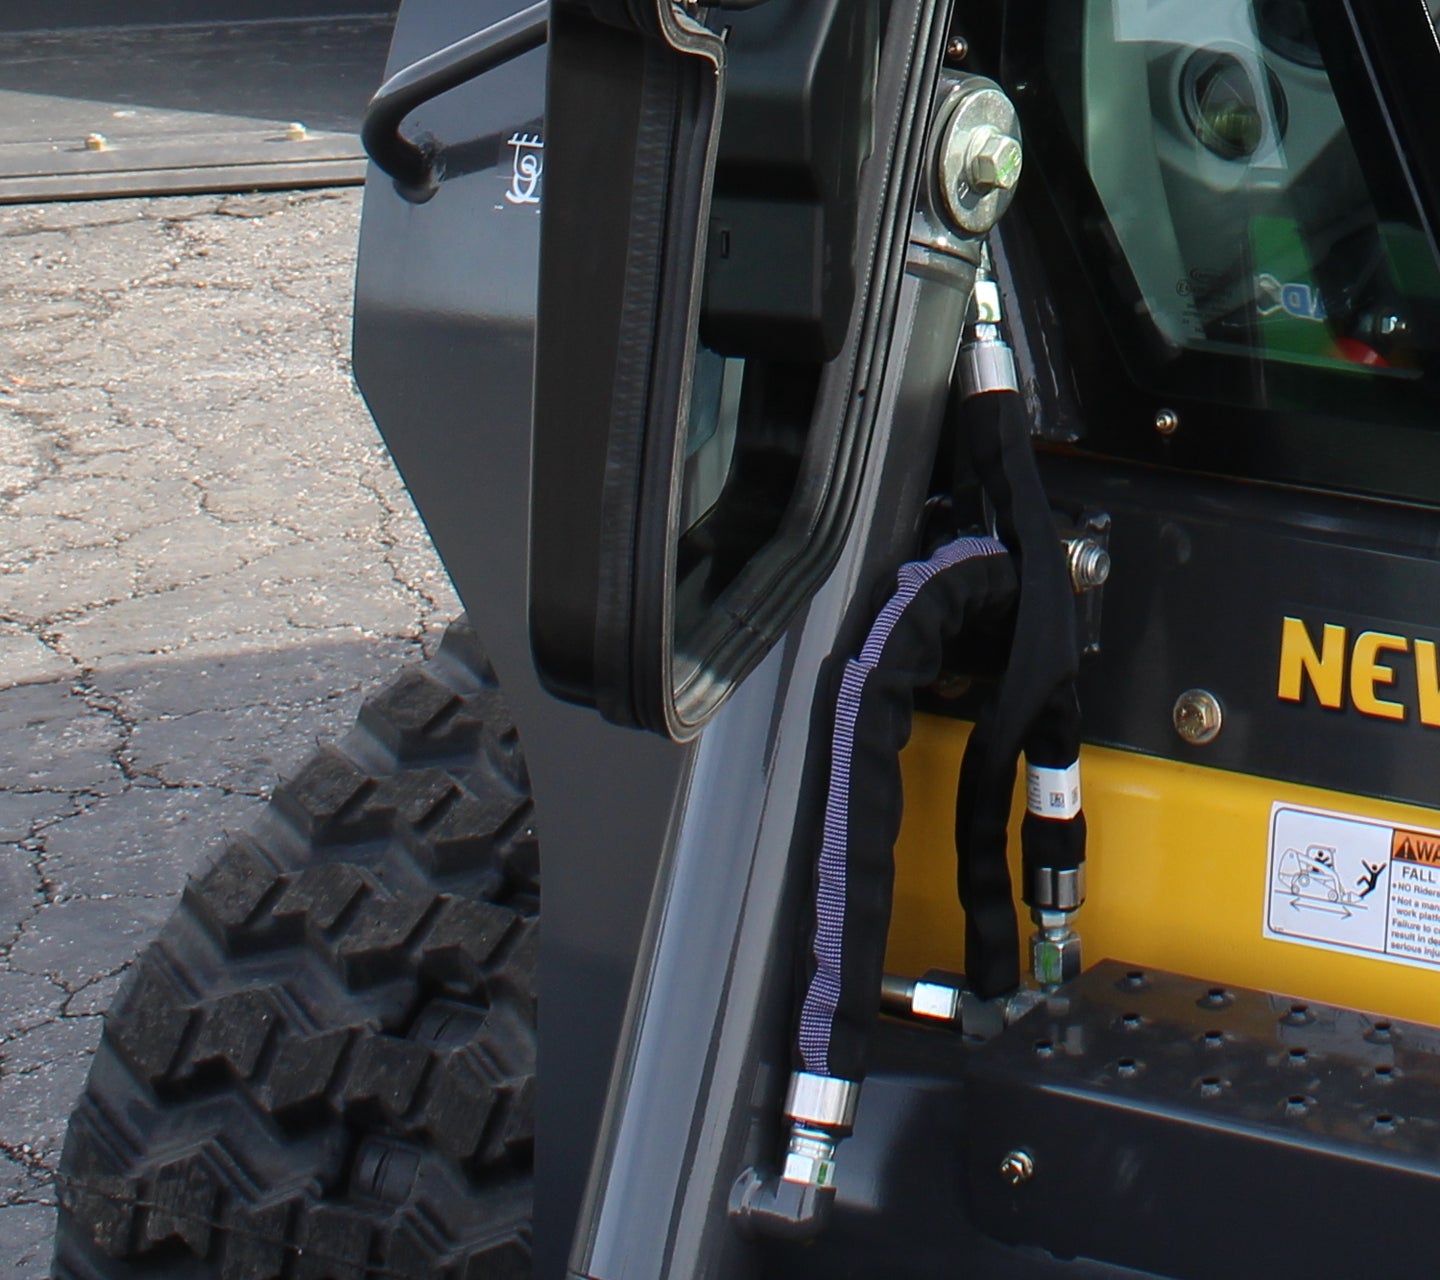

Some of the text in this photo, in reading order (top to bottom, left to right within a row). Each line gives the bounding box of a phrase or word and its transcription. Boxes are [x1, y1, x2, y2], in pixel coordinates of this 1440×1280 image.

[1401, 865, 1436, 884] FALL
[1398, 882, 1412, 893] NO
[1397, 896, 1412, 907] Not
[1396, 908, 1417, 918] work
[1391, 918, 1421, 930] Failure
[1423, 924, 1432, 933] to
[1391, 930, 1415, 941] result
[1417, 934, 1426, 943] in
[1390, 940, 1422, 954] serious
